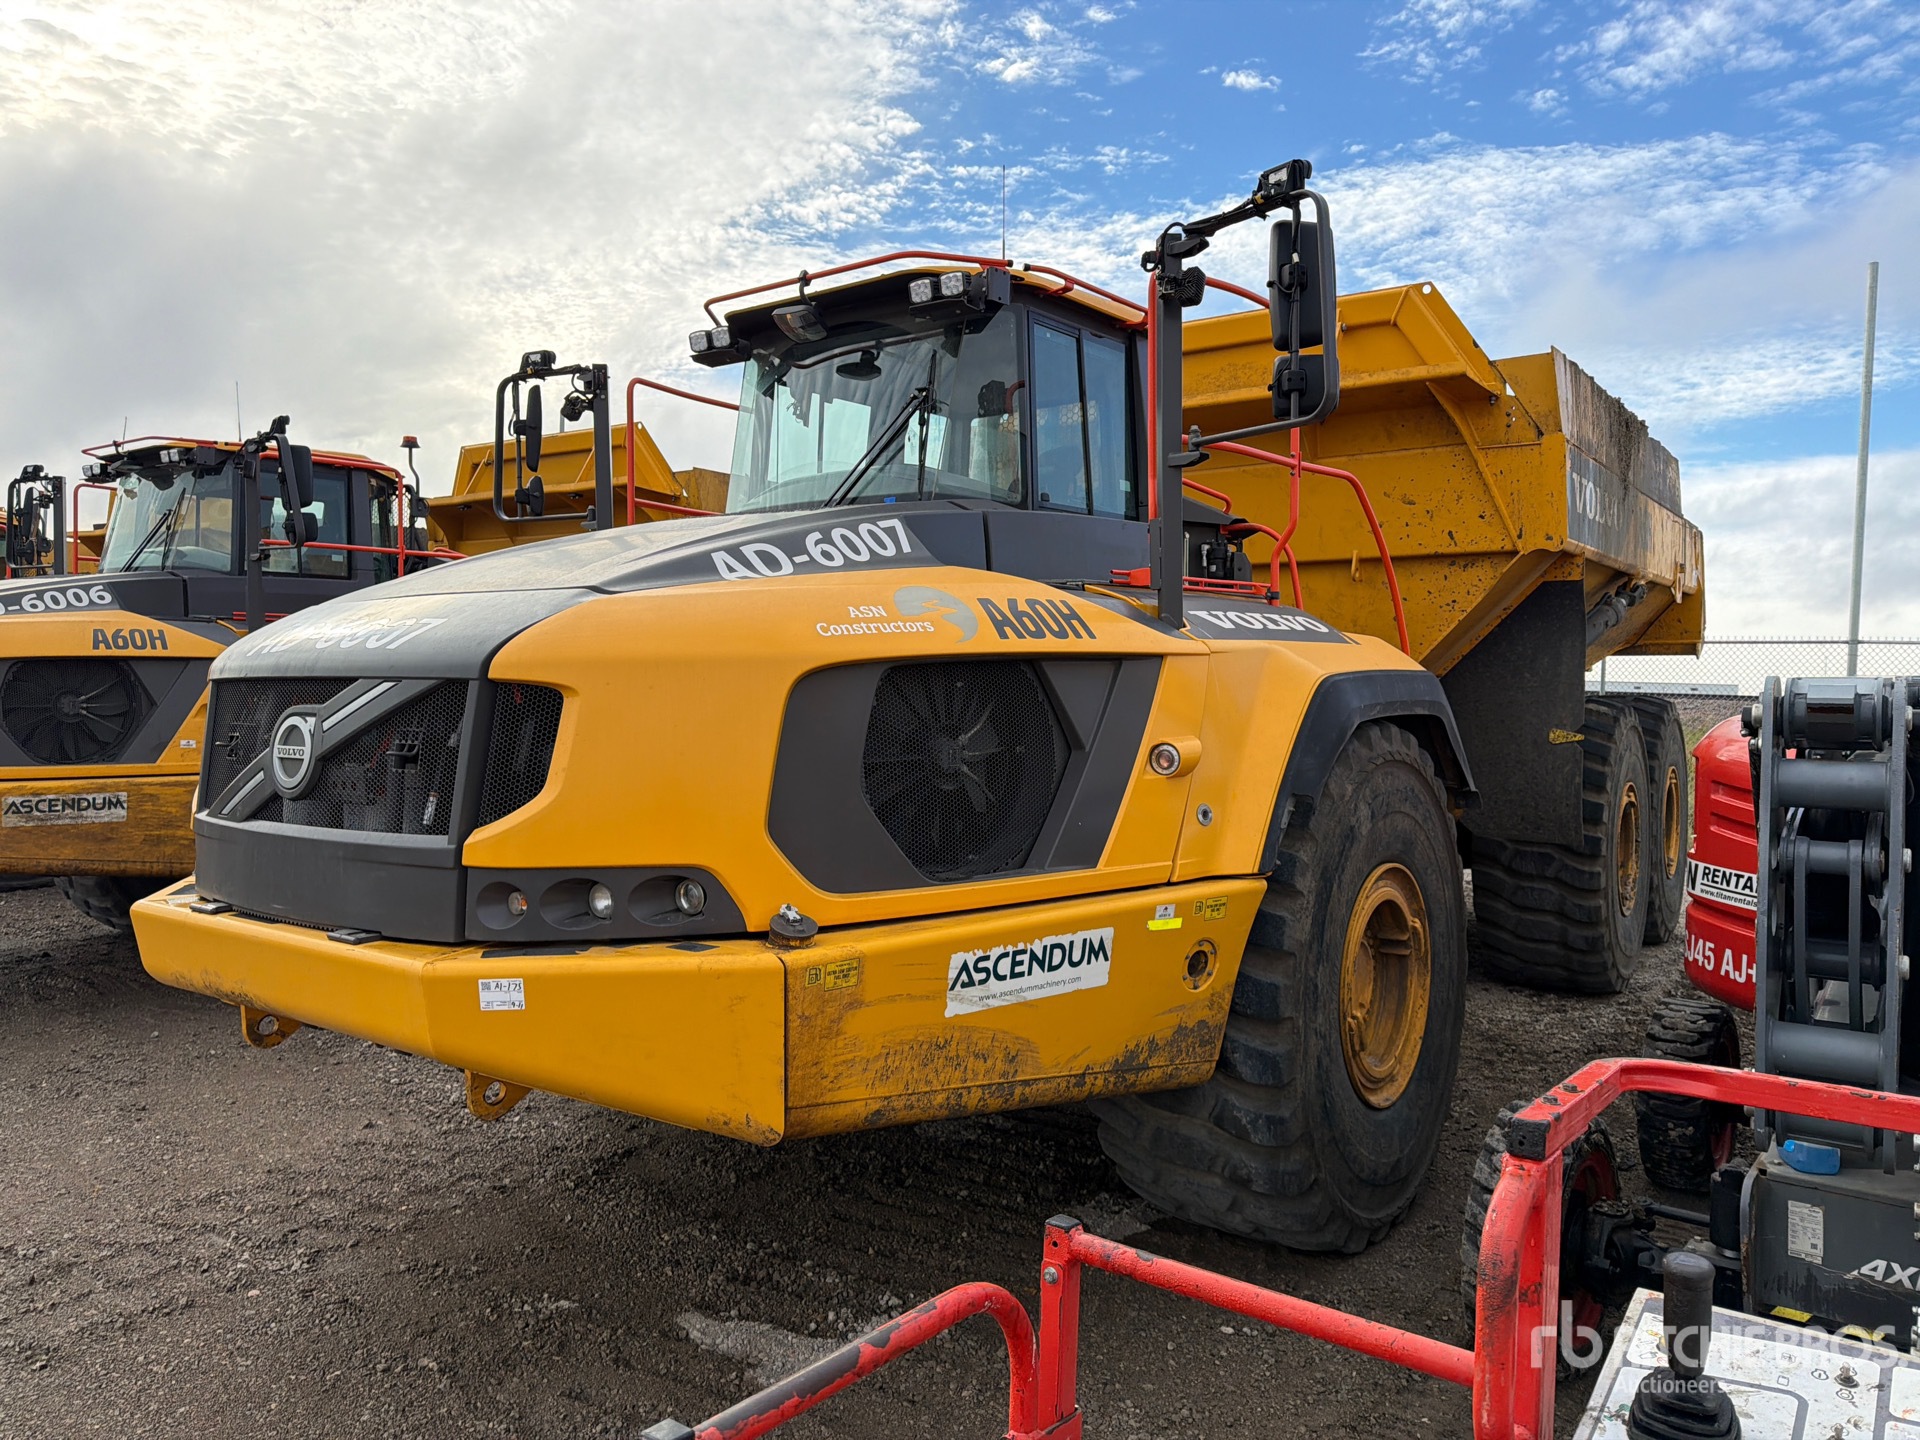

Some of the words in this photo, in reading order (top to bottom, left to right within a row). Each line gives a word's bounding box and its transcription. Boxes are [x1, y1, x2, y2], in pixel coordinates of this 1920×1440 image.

[711, 518, 911, 581] AD-6007
[848, 605, 887, 617] ASN
[976, 597, 1097, 639] A60H
[1187, 610, 1330, 633] VOLVO
[92, 628, 168, 650] A60H
[816, 620, 934, 636] Constructors
[277, 747, 305, 757] VOLVO
[3, 797, 125, 815] ASCENDUM
[949, 935, 1109, 991] ASCENDUM
[978, 976, 1082, 1001] www.ascendummachinery.com
[1860, 1258, 1920, 1291] 4X
